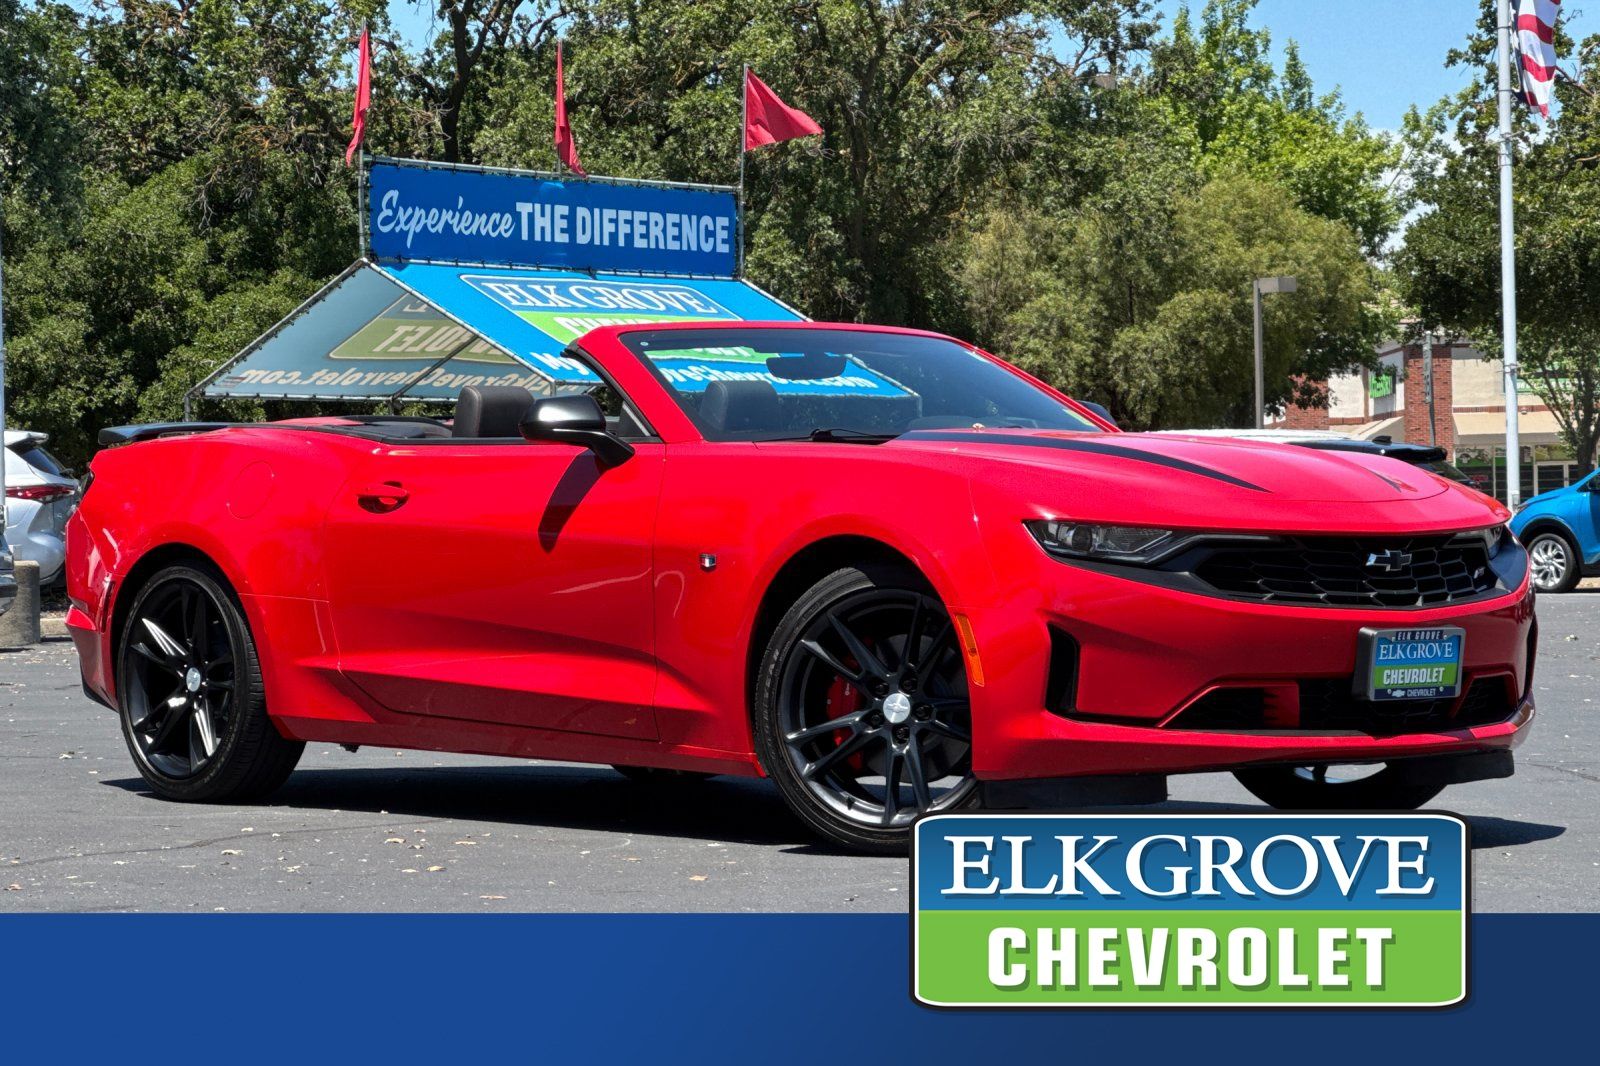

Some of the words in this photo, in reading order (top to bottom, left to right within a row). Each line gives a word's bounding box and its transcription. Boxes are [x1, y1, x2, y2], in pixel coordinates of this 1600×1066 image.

[376, 189, 515, 248] Experience
[516, 202, 569, 243] THE
[575, 207, 730, 253] DIFFERENCE
[480, 282, 587, 308] ELK
[568, 285, 719, 314] GROVE
[1397, 631, 1412, 640] ELK
[1415, 630, 1441, 640] GROVE
[1378, 644, 1406, 660] ELK
[1406, 642, 1454, 659] GROVE
[1383, 667, 1445, 685] CHEVROLET
[1406, 688, 1437, 697] CHEVROLET
